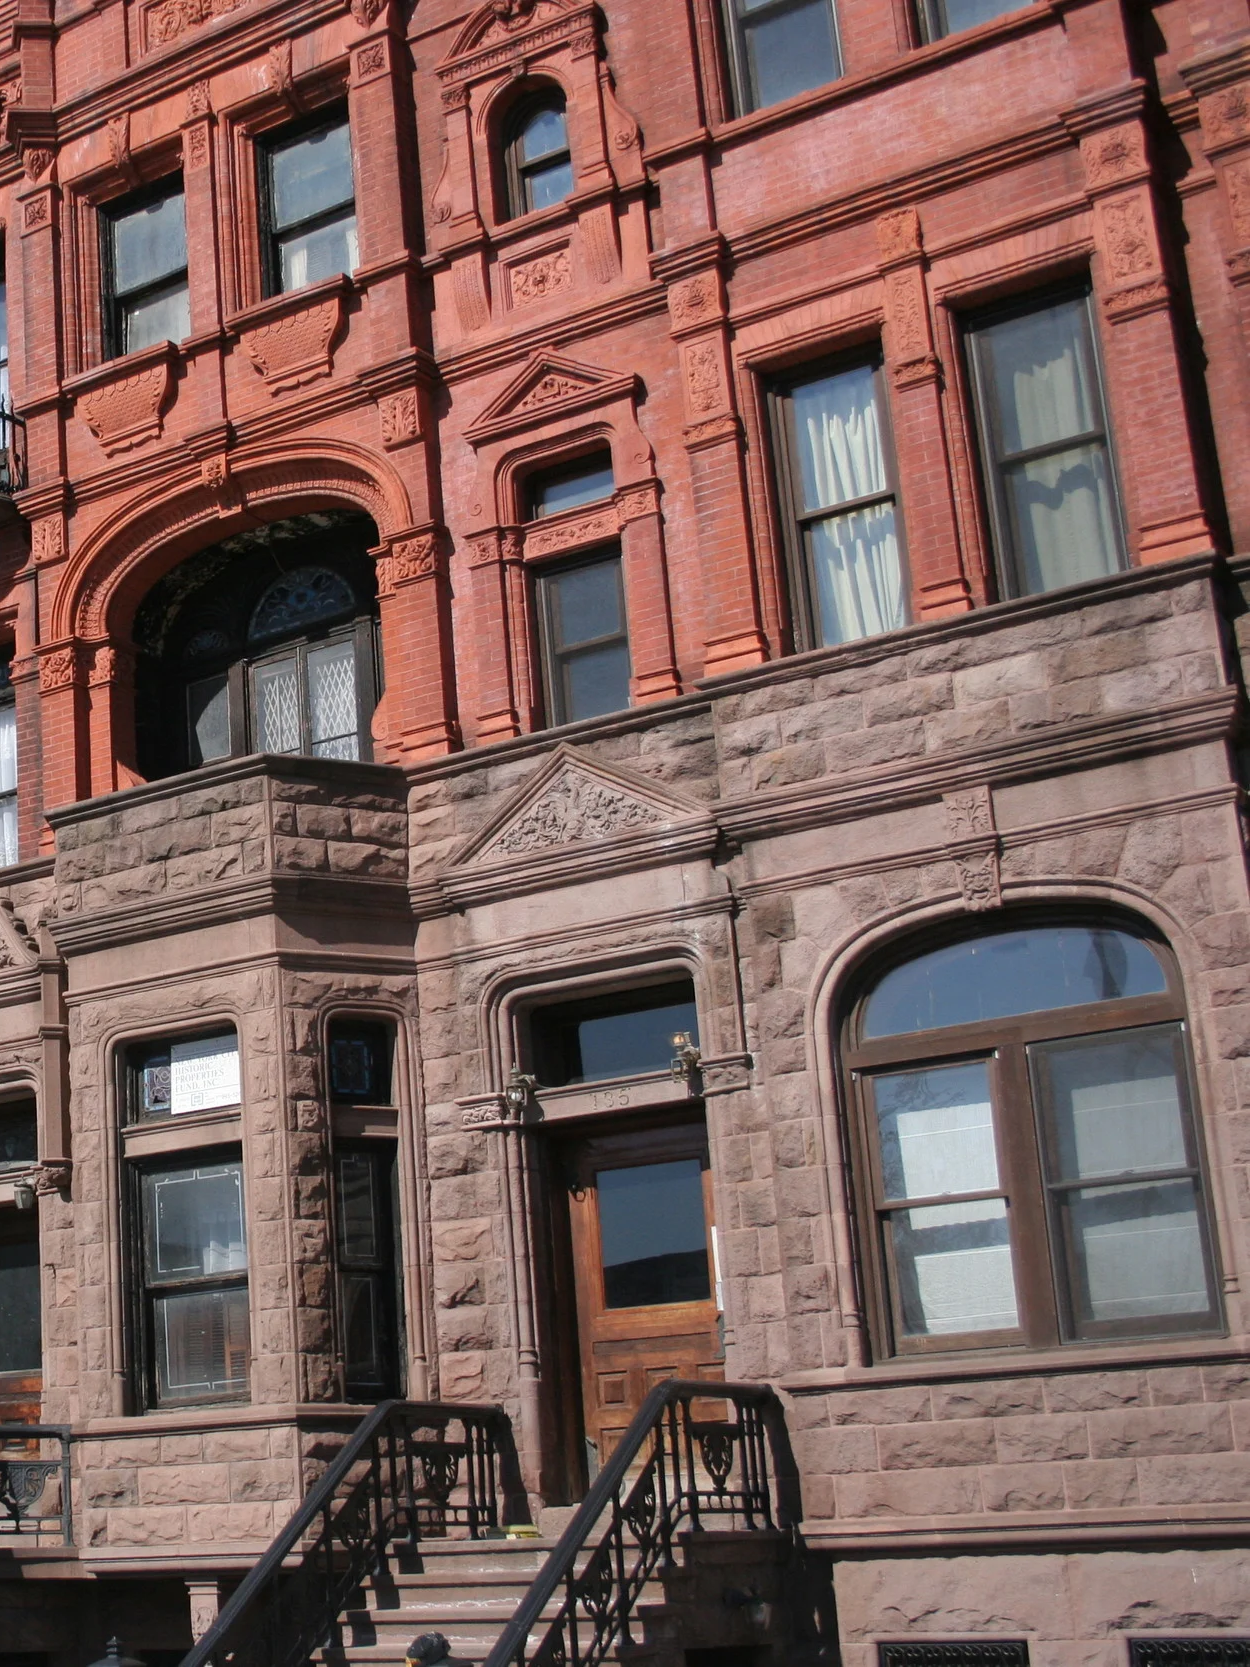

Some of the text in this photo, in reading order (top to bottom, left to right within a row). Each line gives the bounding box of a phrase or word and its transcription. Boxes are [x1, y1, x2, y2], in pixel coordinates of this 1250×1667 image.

[175, 1062, 213, 1075] HISTORIC
[175, 1069, 224, 1084] PROPERTIES
[590, 1087, 631, 1110] 135
